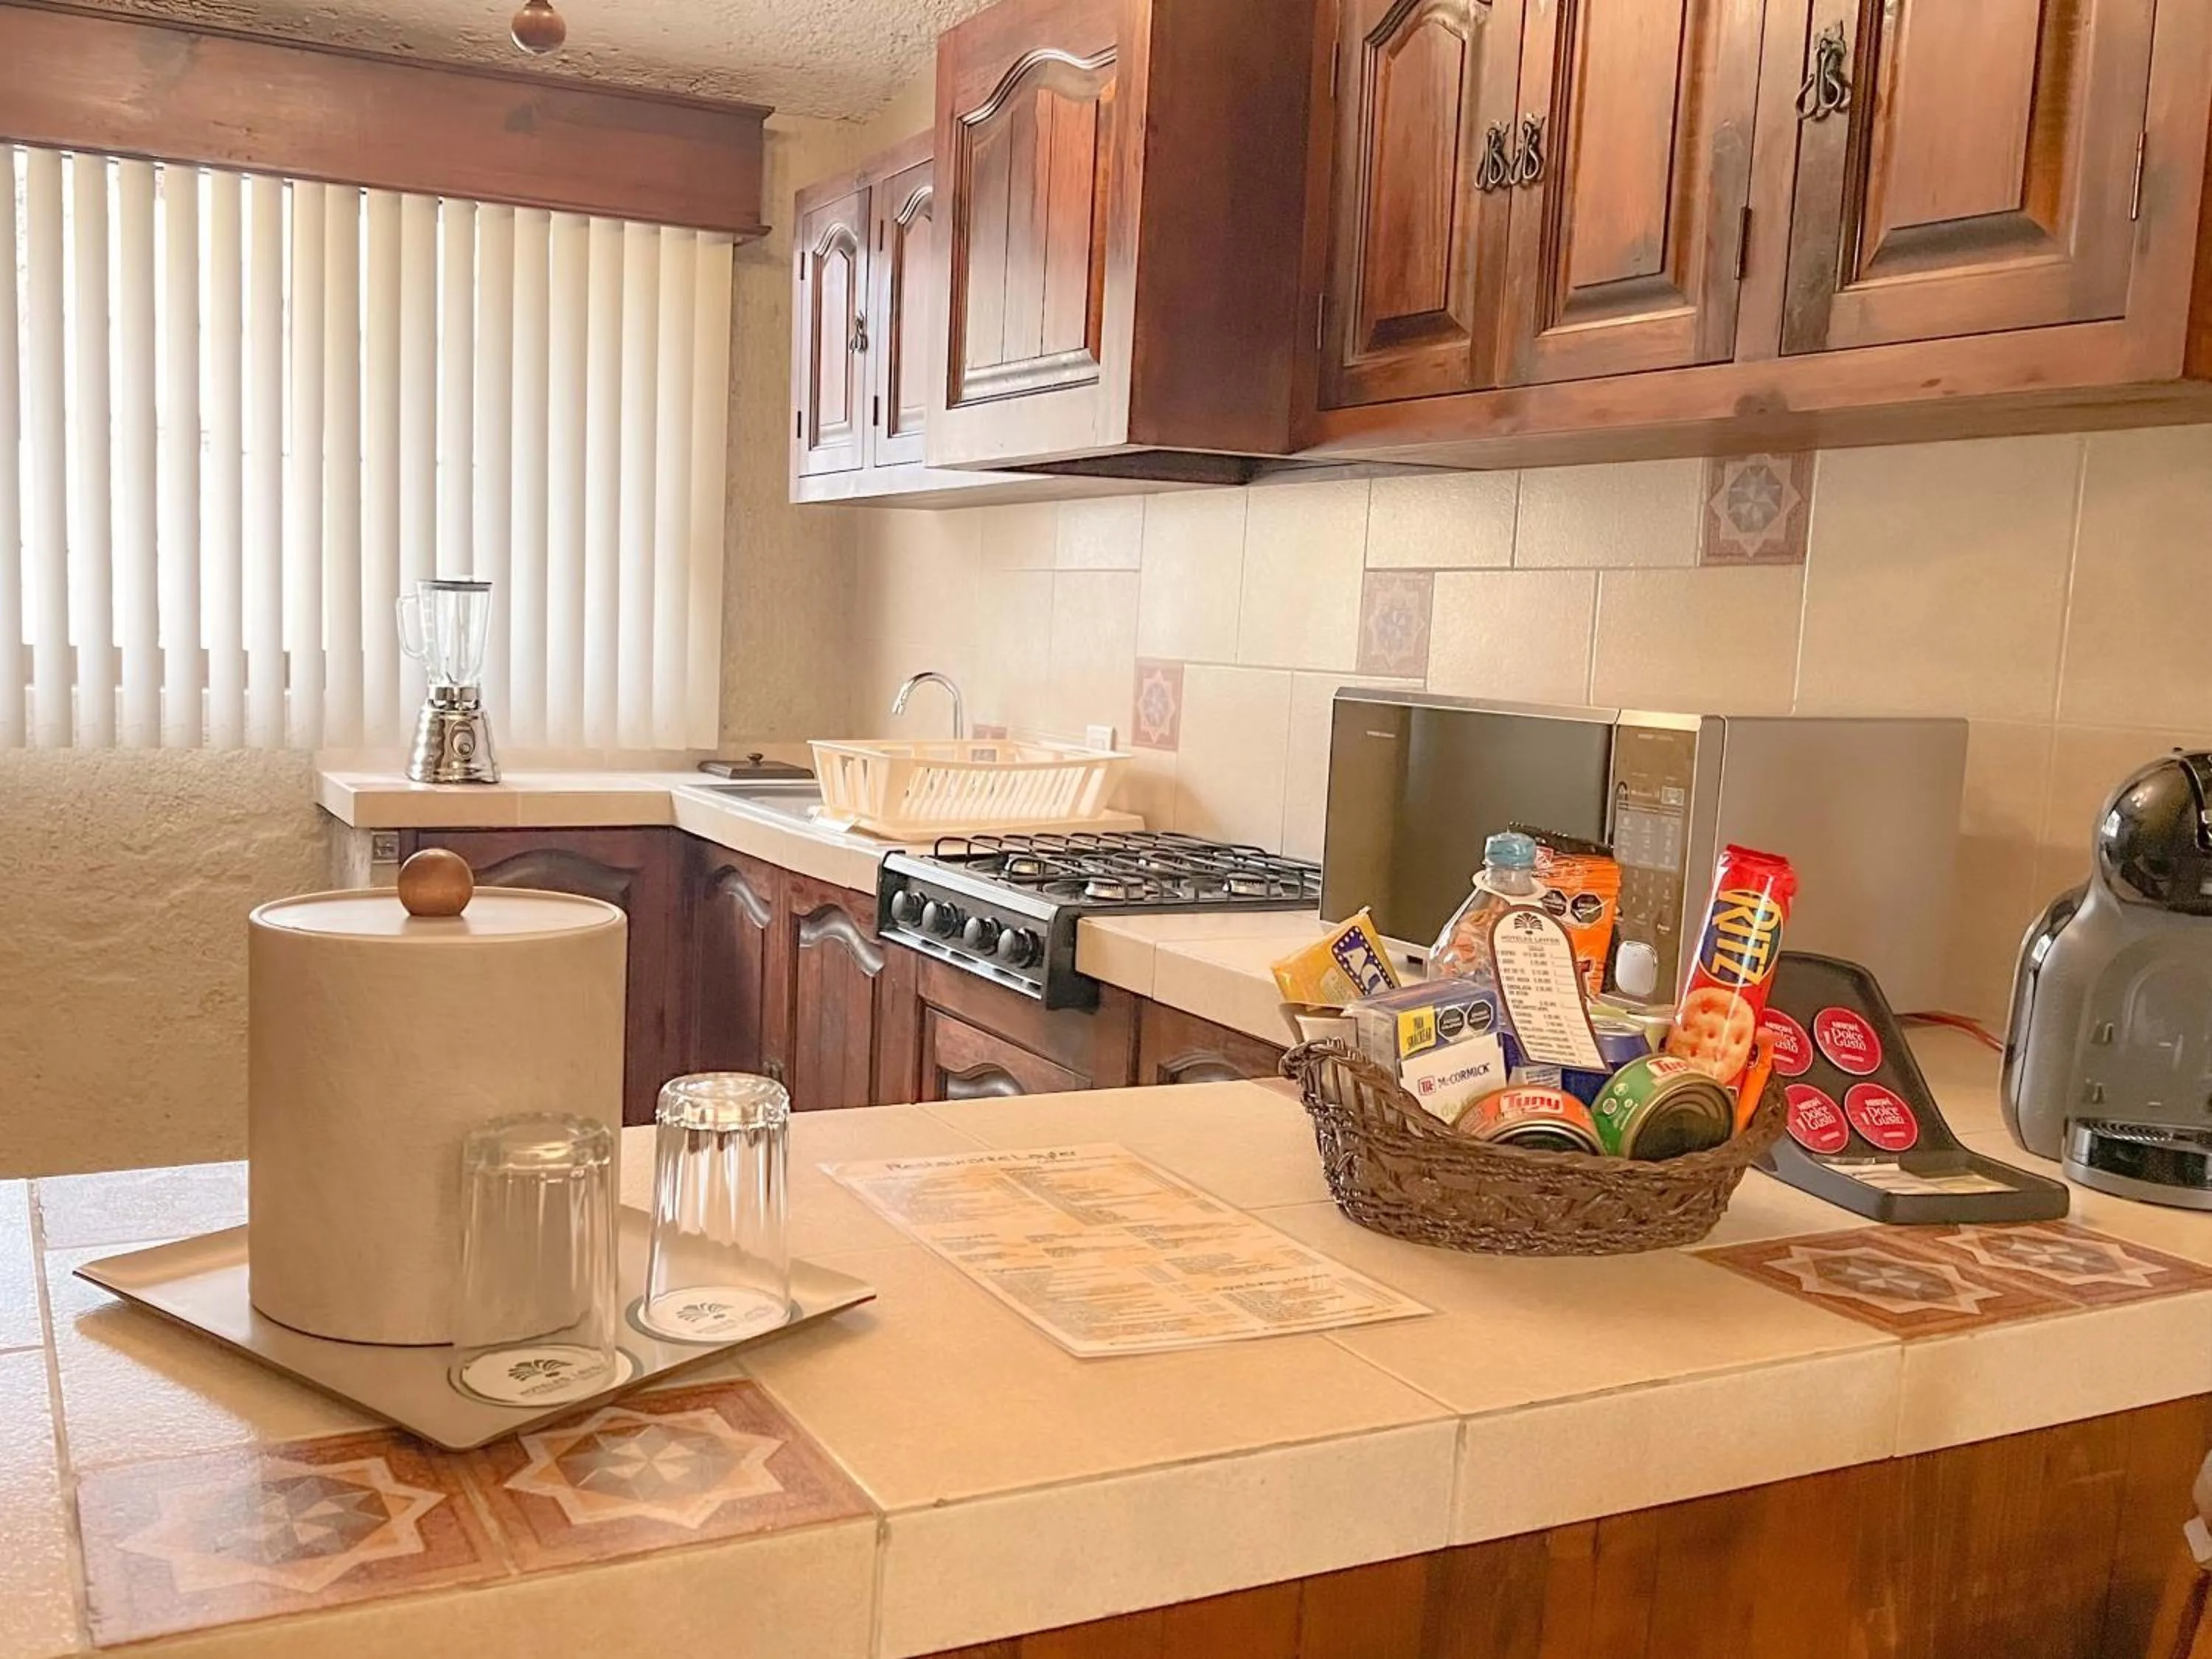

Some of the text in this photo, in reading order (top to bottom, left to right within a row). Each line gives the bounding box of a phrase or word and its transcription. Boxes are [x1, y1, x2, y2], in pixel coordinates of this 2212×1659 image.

[1712, 891, 1781, 985] RITZ
[1831, 1028, 1864, 1041] Dolce
[1834, 1037, 1867, 1051] Gusto
[1503, 1092, 1561, 1112] Tuny
[1800, 1105, 1829, 1123] Dolce
[1866, 1106, 1900, 1119] Dolce
[1871, 1113, 1905, 1127] Gusto
[1806, 1113, 1837, 1130] Gusto
